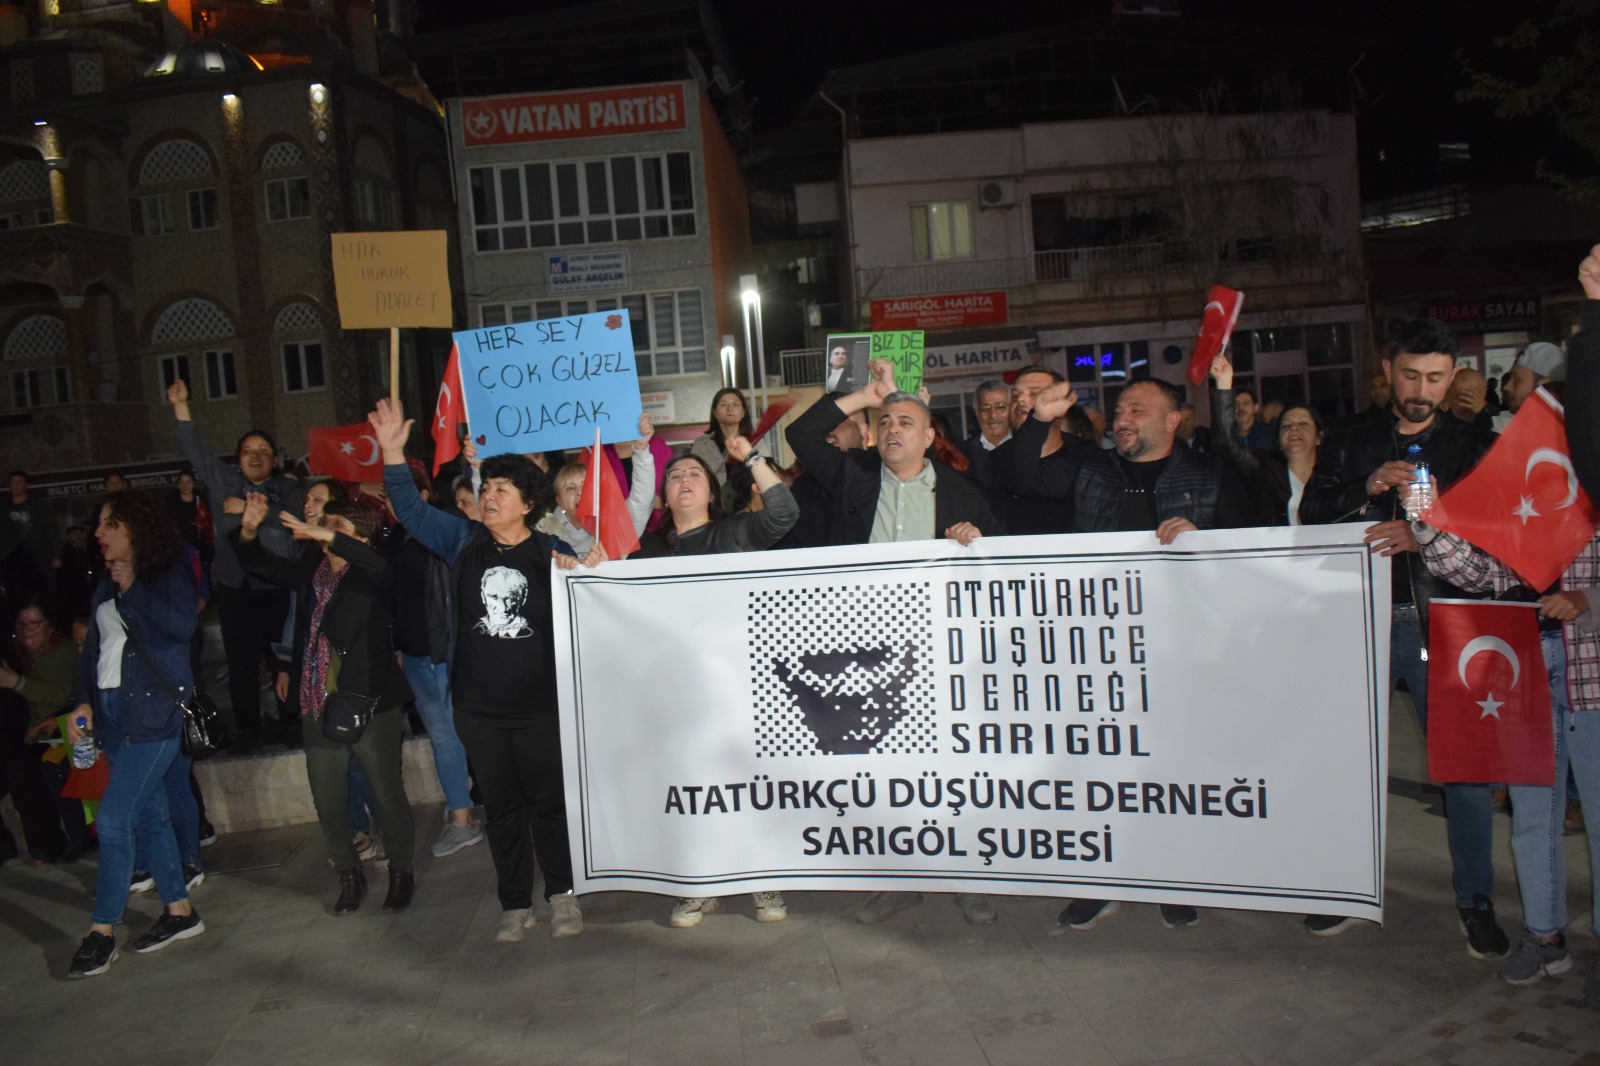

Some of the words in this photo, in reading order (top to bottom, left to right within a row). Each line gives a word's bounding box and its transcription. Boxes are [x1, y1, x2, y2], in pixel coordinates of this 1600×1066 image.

[500, 103, 581, 134] VATAN
[589, 94, 678, 129] PARTİSİ
[341, 240, 381, 260] HAK
[361, 265, 410, 281] HUKUK
[586, 270, 624, 282] AKÇELİK
[375, 290, 438, 313] ADALET
[883, 299, 941, 313] SARIGÖL
[945, 295, 993, 309] HARİTA
[1428, 304, 1481, 320] BURAK
[1485, 301, 1537, 318] SAYAR
[475, 326, 523, 353] HER
[536, 317, 583, 344] ŞEY
[901, 331, 922, 349] DE
[478, 363, 541, 393] ÇOK
[552, 352, 630, 381] GÜZEL
[955, 347, 1021, 365] HARİTA
[496, 401, 610, 438] OLACAK
[130, 475, 169, 488] BİRGÜL
[945, 570, 1143, 619] ATATÜRKÇÜ
[947, 620, 1146, 667] DÜŞÜNCE
[950, 667, 1149, 712] DERNEĞİ
[951, 718, 1150, 756] SARIGÖL
[665, 771, 876, 816] ATATÜRKÇÜ
[889, 771, 1074, 816] DÜŞÜNCE
[1087, 778, 1268, 819] DERNEĞİ
[802, 819, 967, 856] SARIGÖL
[977, 823, 1113, 865] ŞUBESİ
